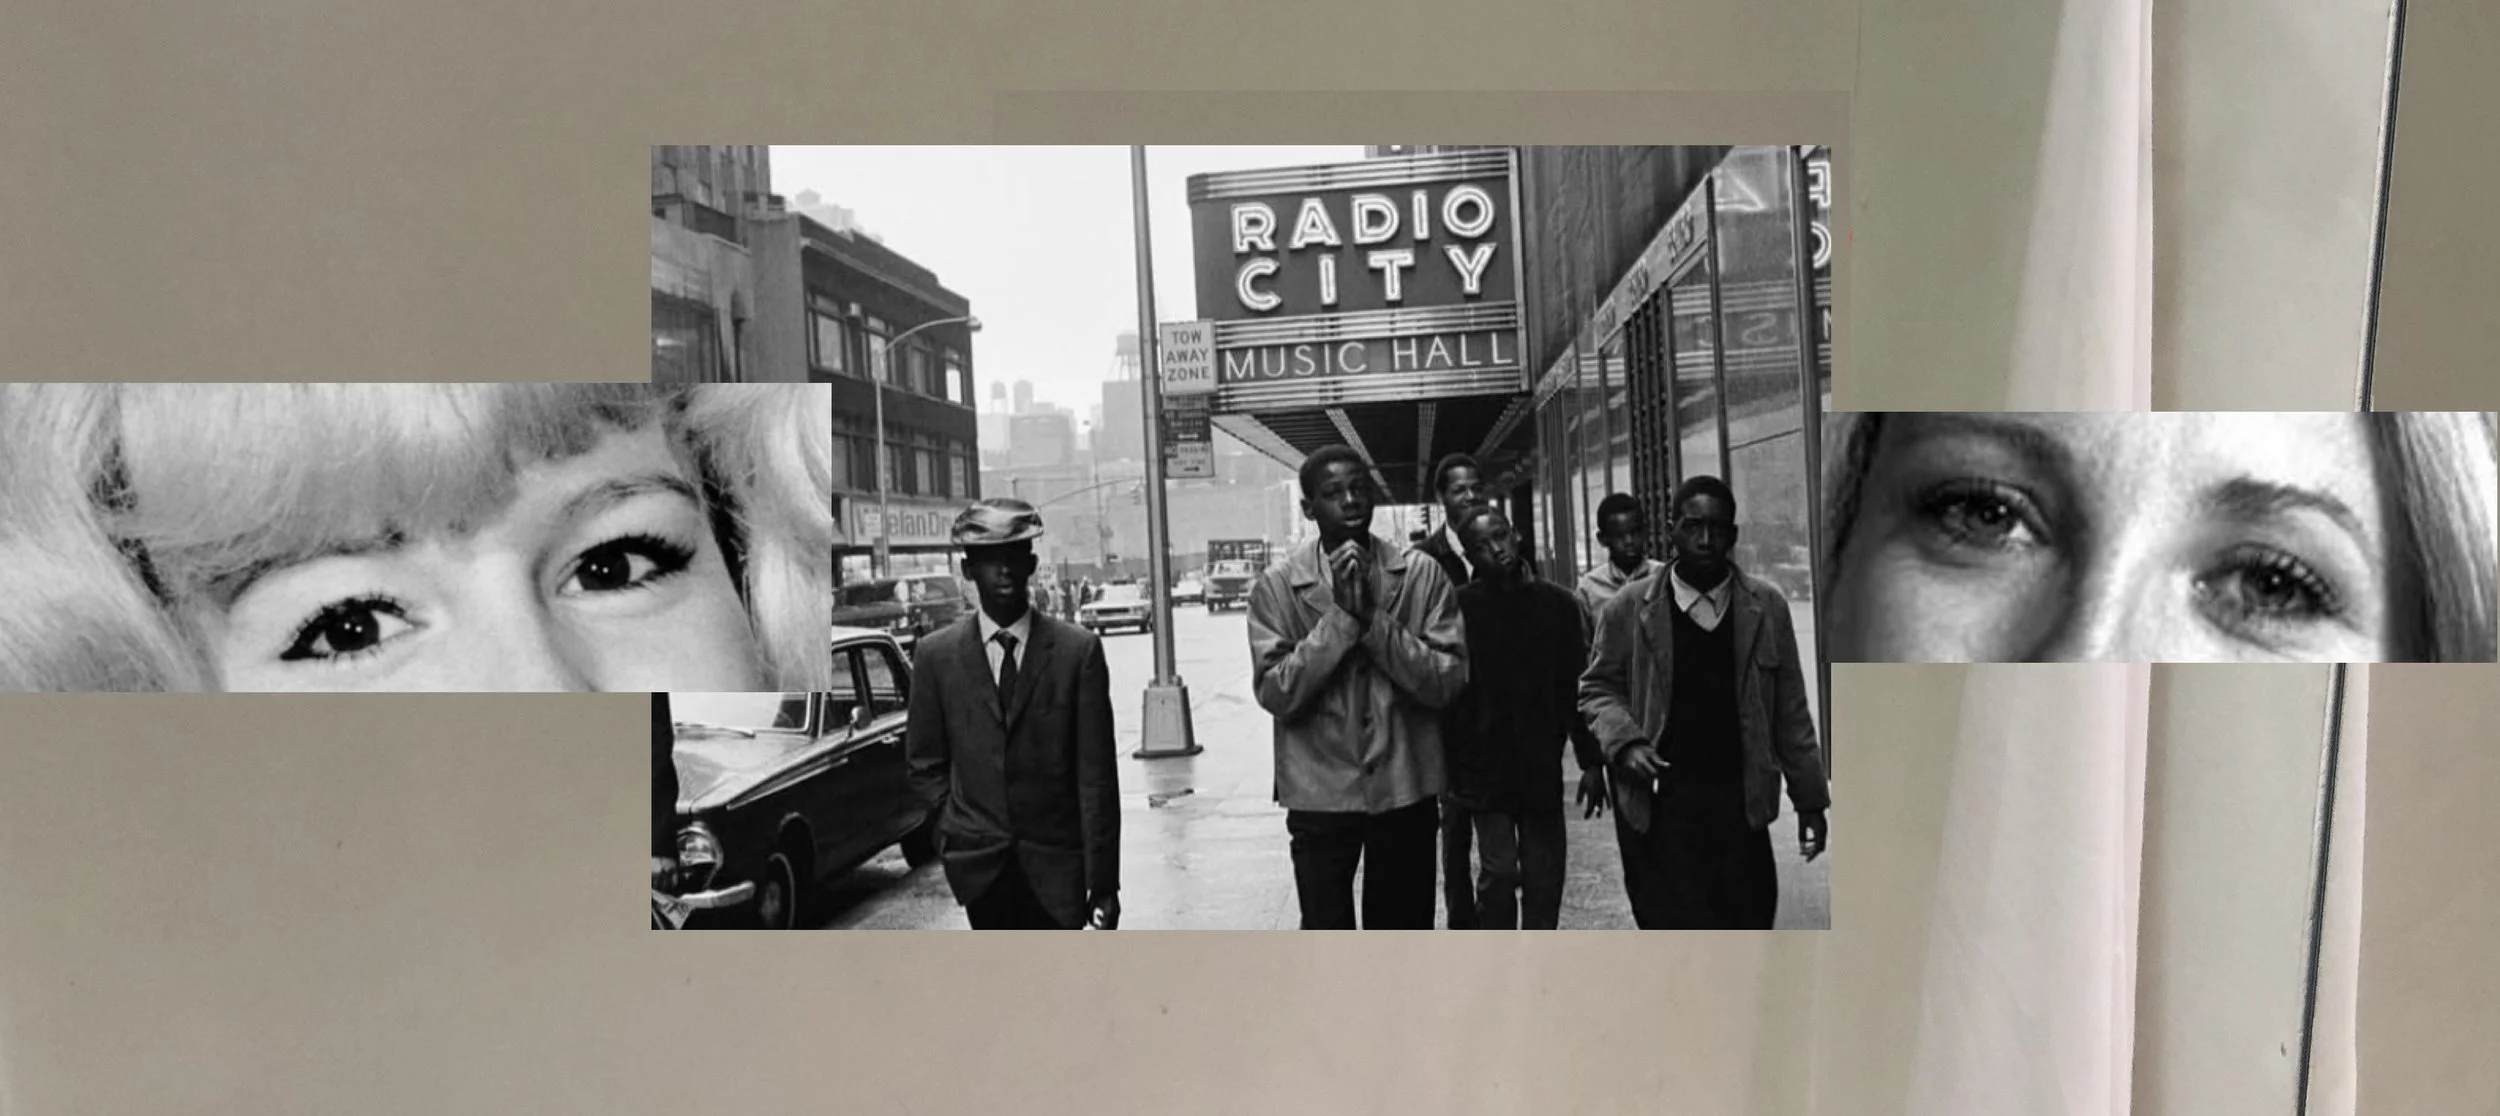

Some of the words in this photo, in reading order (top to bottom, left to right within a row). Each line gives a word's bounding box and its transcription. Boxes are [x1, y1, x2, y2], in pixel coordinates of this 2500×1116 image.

[1232, 186, 1494, 253] RADIO
[1237, 243, 1497, 311] CITY
[1171, 330, 1202, 345] TOW
[1166, 348, 1209, 363] AWAY
[1226, 342, 1367, 380] MUSIC
[1394, 333, 1513, 370] HALL
[1167, 366, 1211, 382] ZONE
